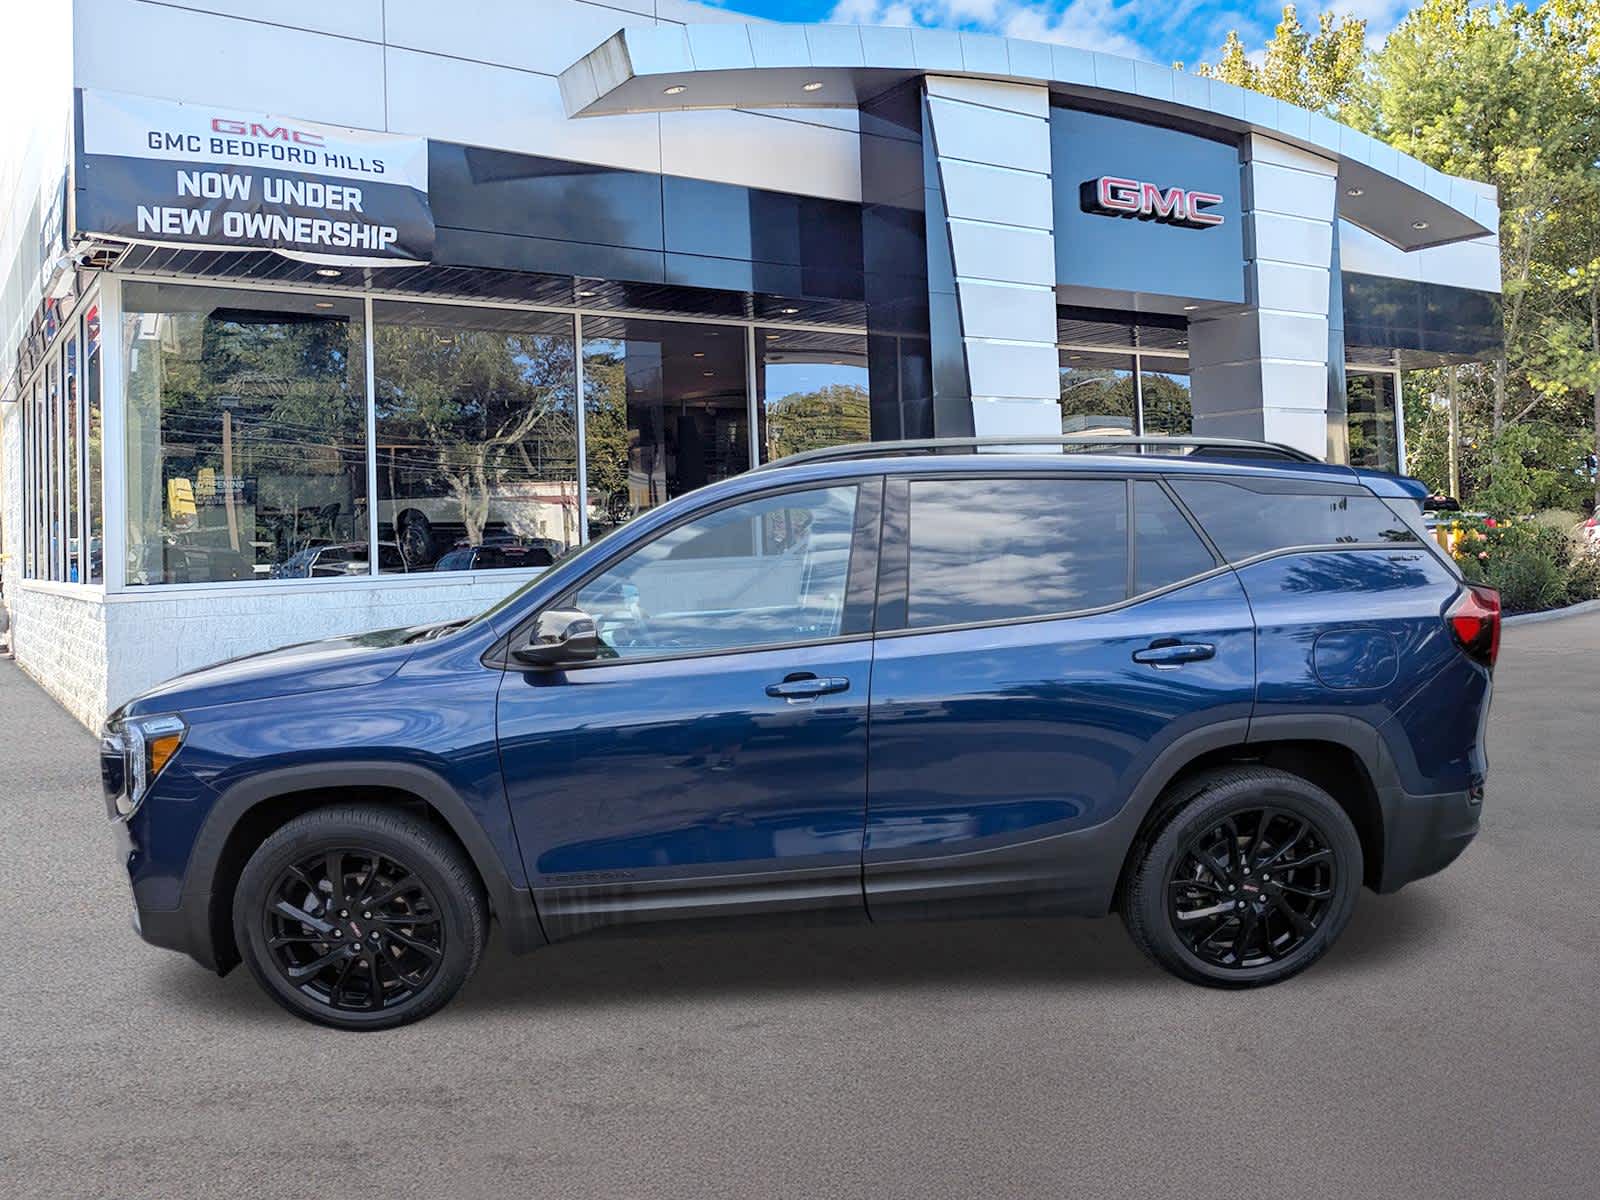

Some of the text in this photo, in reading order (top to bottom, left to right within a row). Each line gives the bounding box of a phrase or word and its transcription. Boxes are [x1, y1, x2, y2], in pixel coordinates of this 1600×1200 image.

[147, 131, 386, 174] GMC BEDFORD HILLS
[211, 117, 326, 148] GMC
[176, 169, 363, 213] NOW UNDER
[1097, 175, 1225, 226] GMC
[136, 205, 399, 251] NEW OWNERSHIP
